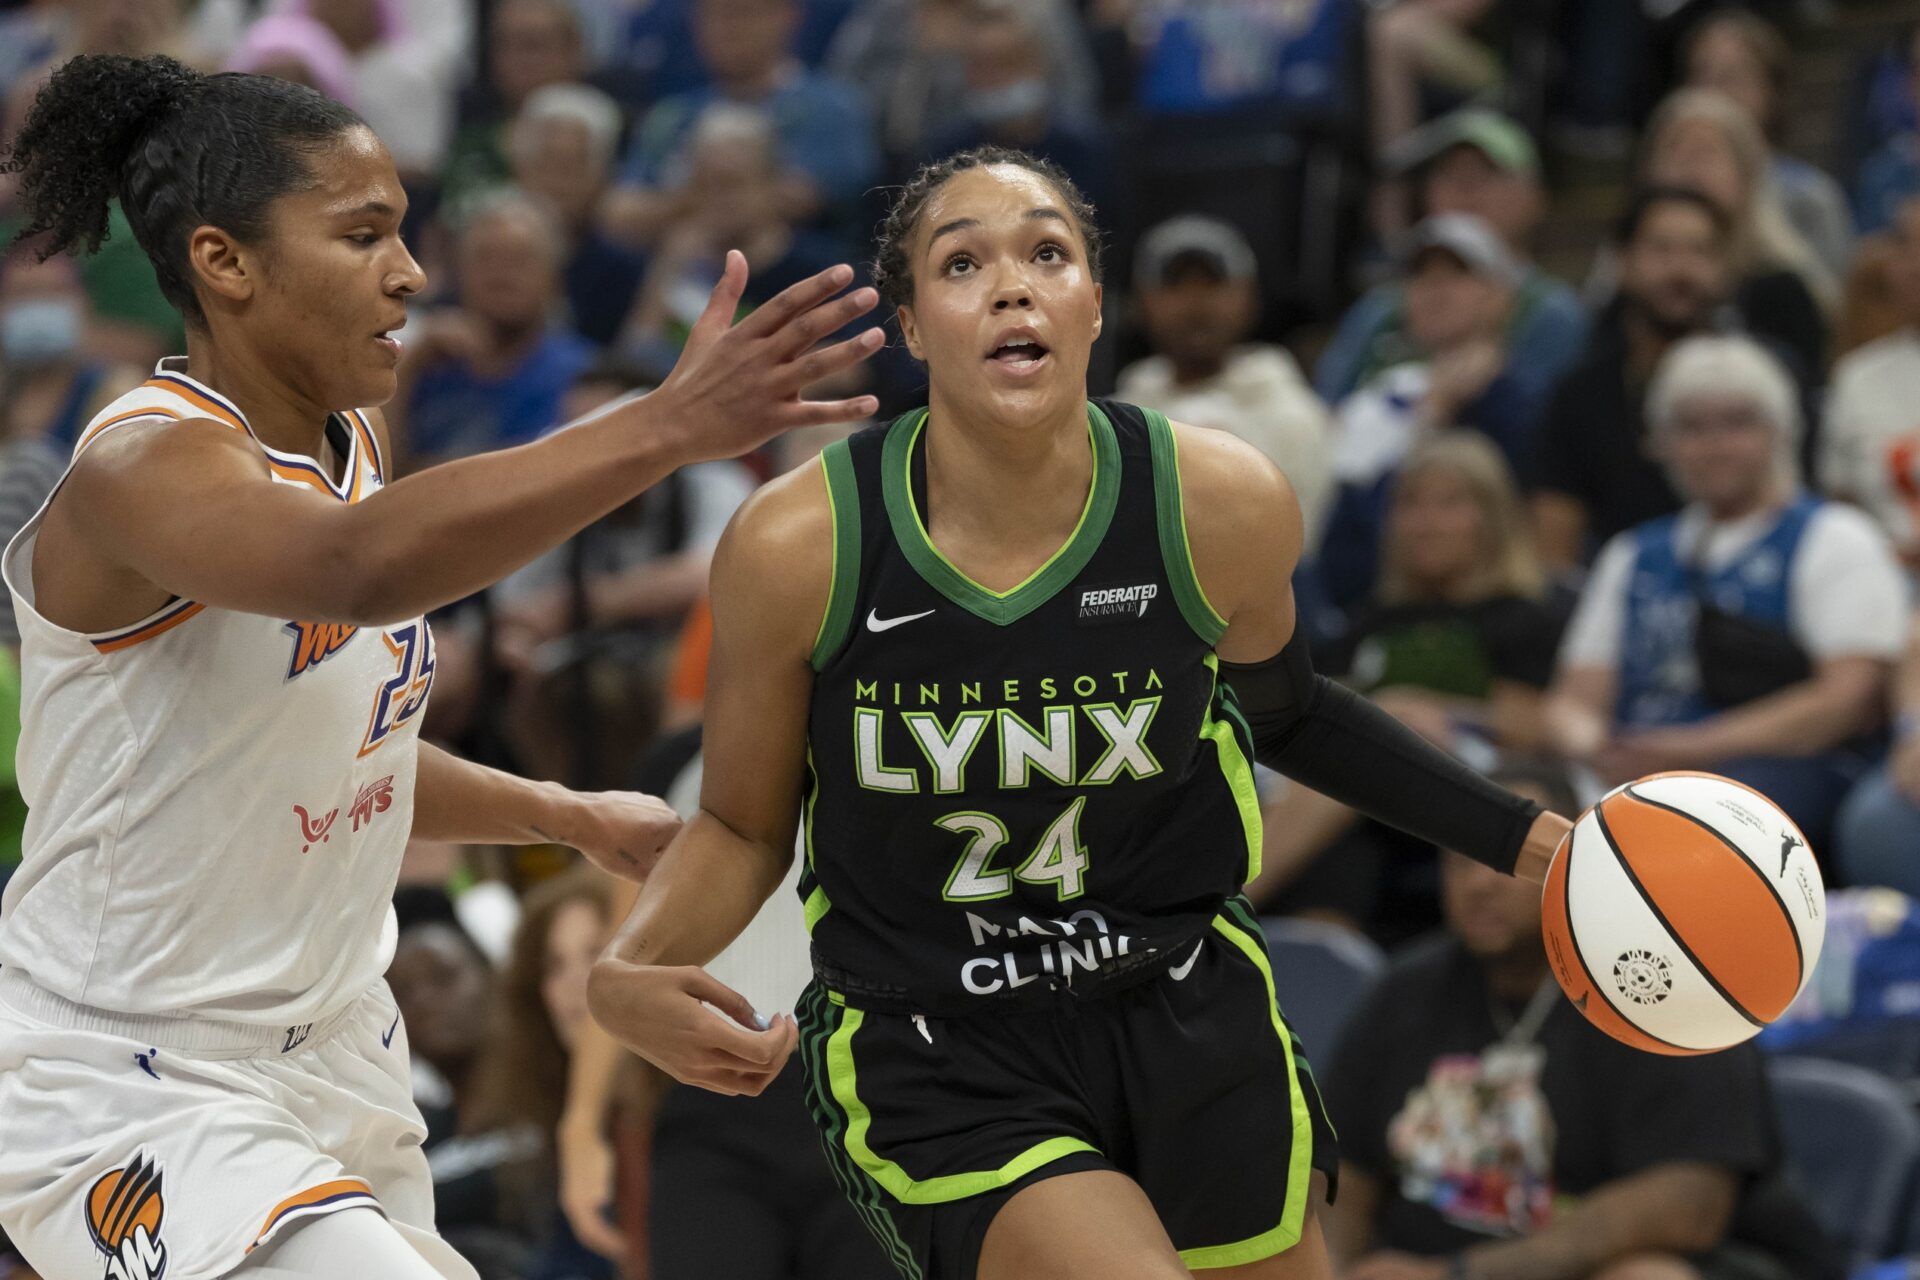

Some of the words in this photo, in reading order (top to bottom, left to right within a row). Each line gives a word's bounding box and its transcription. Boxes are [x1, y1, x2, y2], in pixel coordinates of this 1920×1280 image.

[1079, 602, 1136, 618] INSURANCE
[1080, 583, 1158, 607] FEDERATED
[356, 614, 436, 759] 25
[855, 668, 1164, 705] MINNESOTA
[853, 695, 1165, 795] LYNX
[932, 795, 1091, 902] 24
